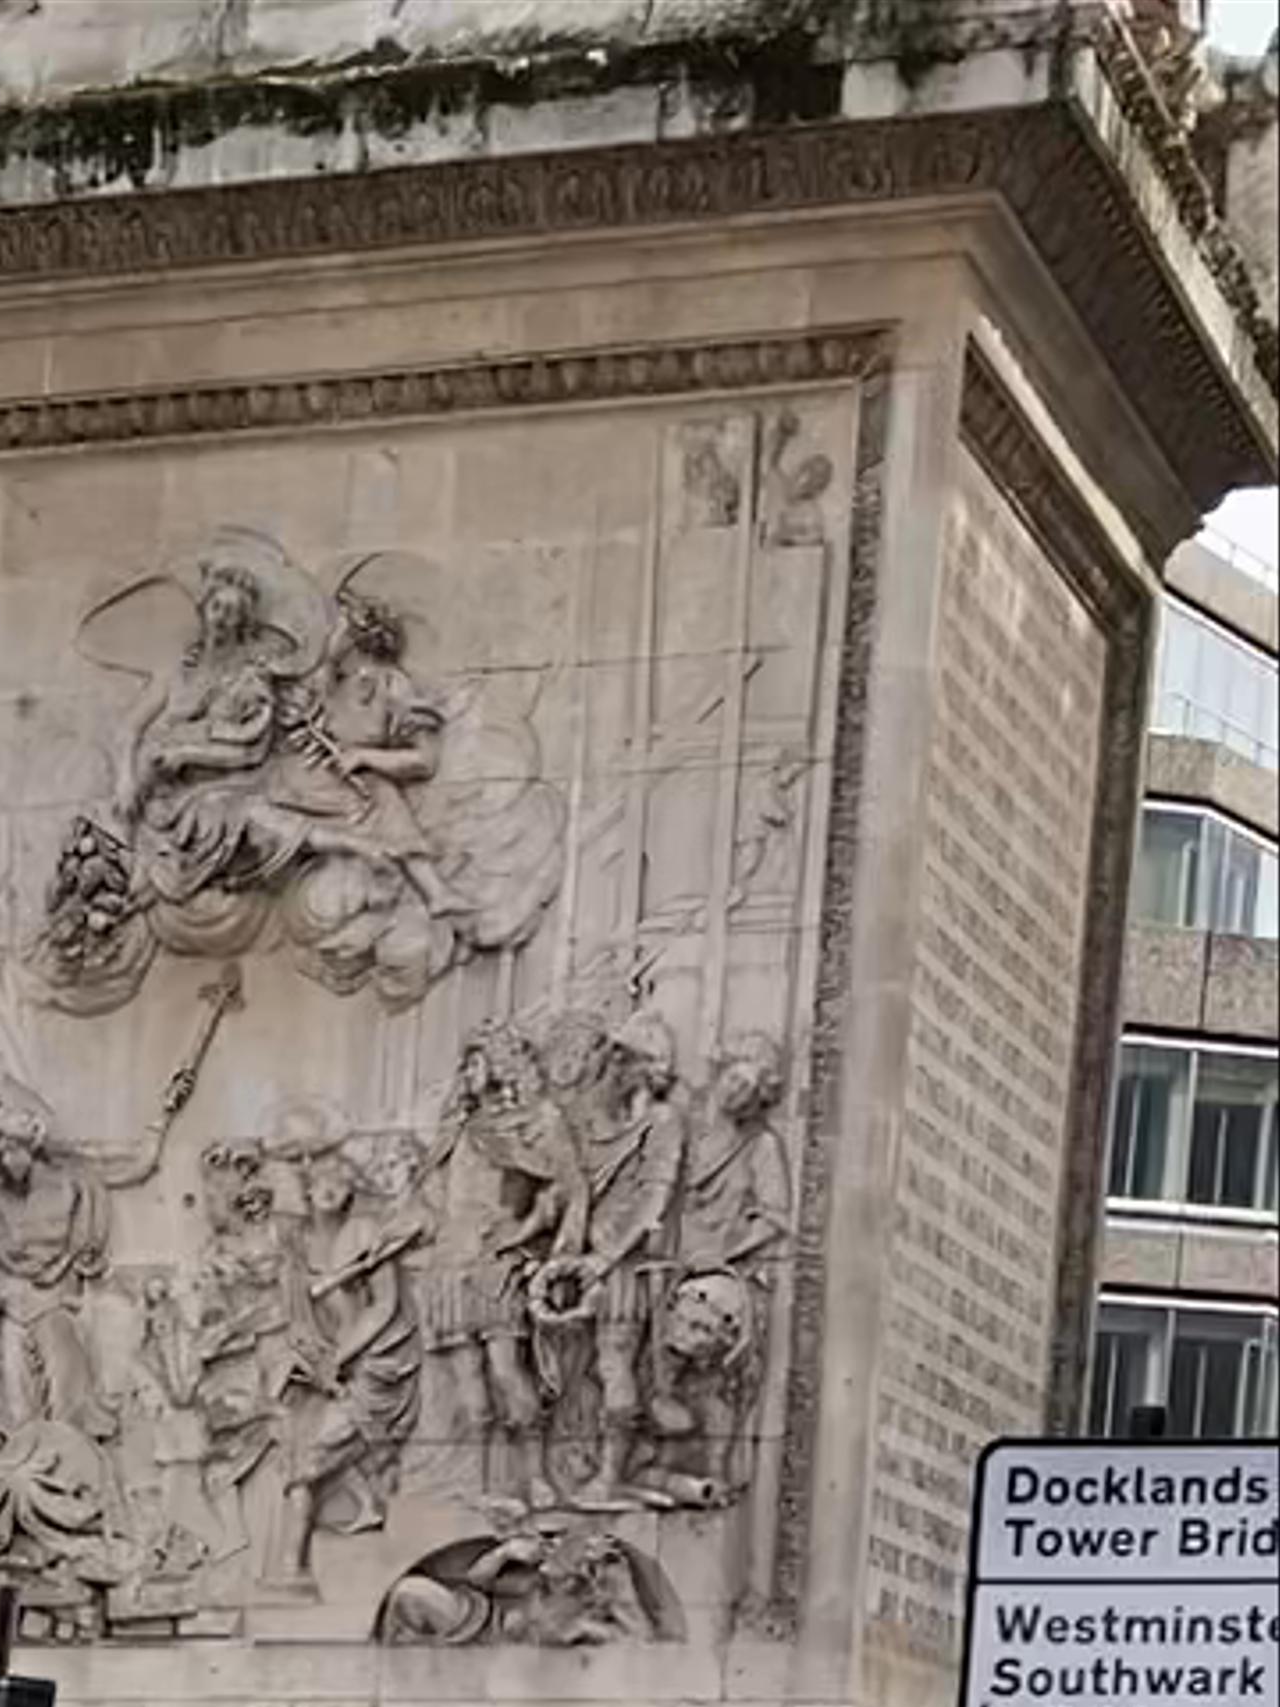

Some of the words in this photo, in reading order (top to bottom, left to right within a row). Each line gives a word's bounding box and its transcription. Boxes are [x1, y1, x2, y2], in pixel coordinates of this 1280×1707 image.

[1006, 1465, 1270, 1506] Docklands
[1004, 1519, 1159, 1558] Tower
[989, 1657, 1265, 1697] Southwark
